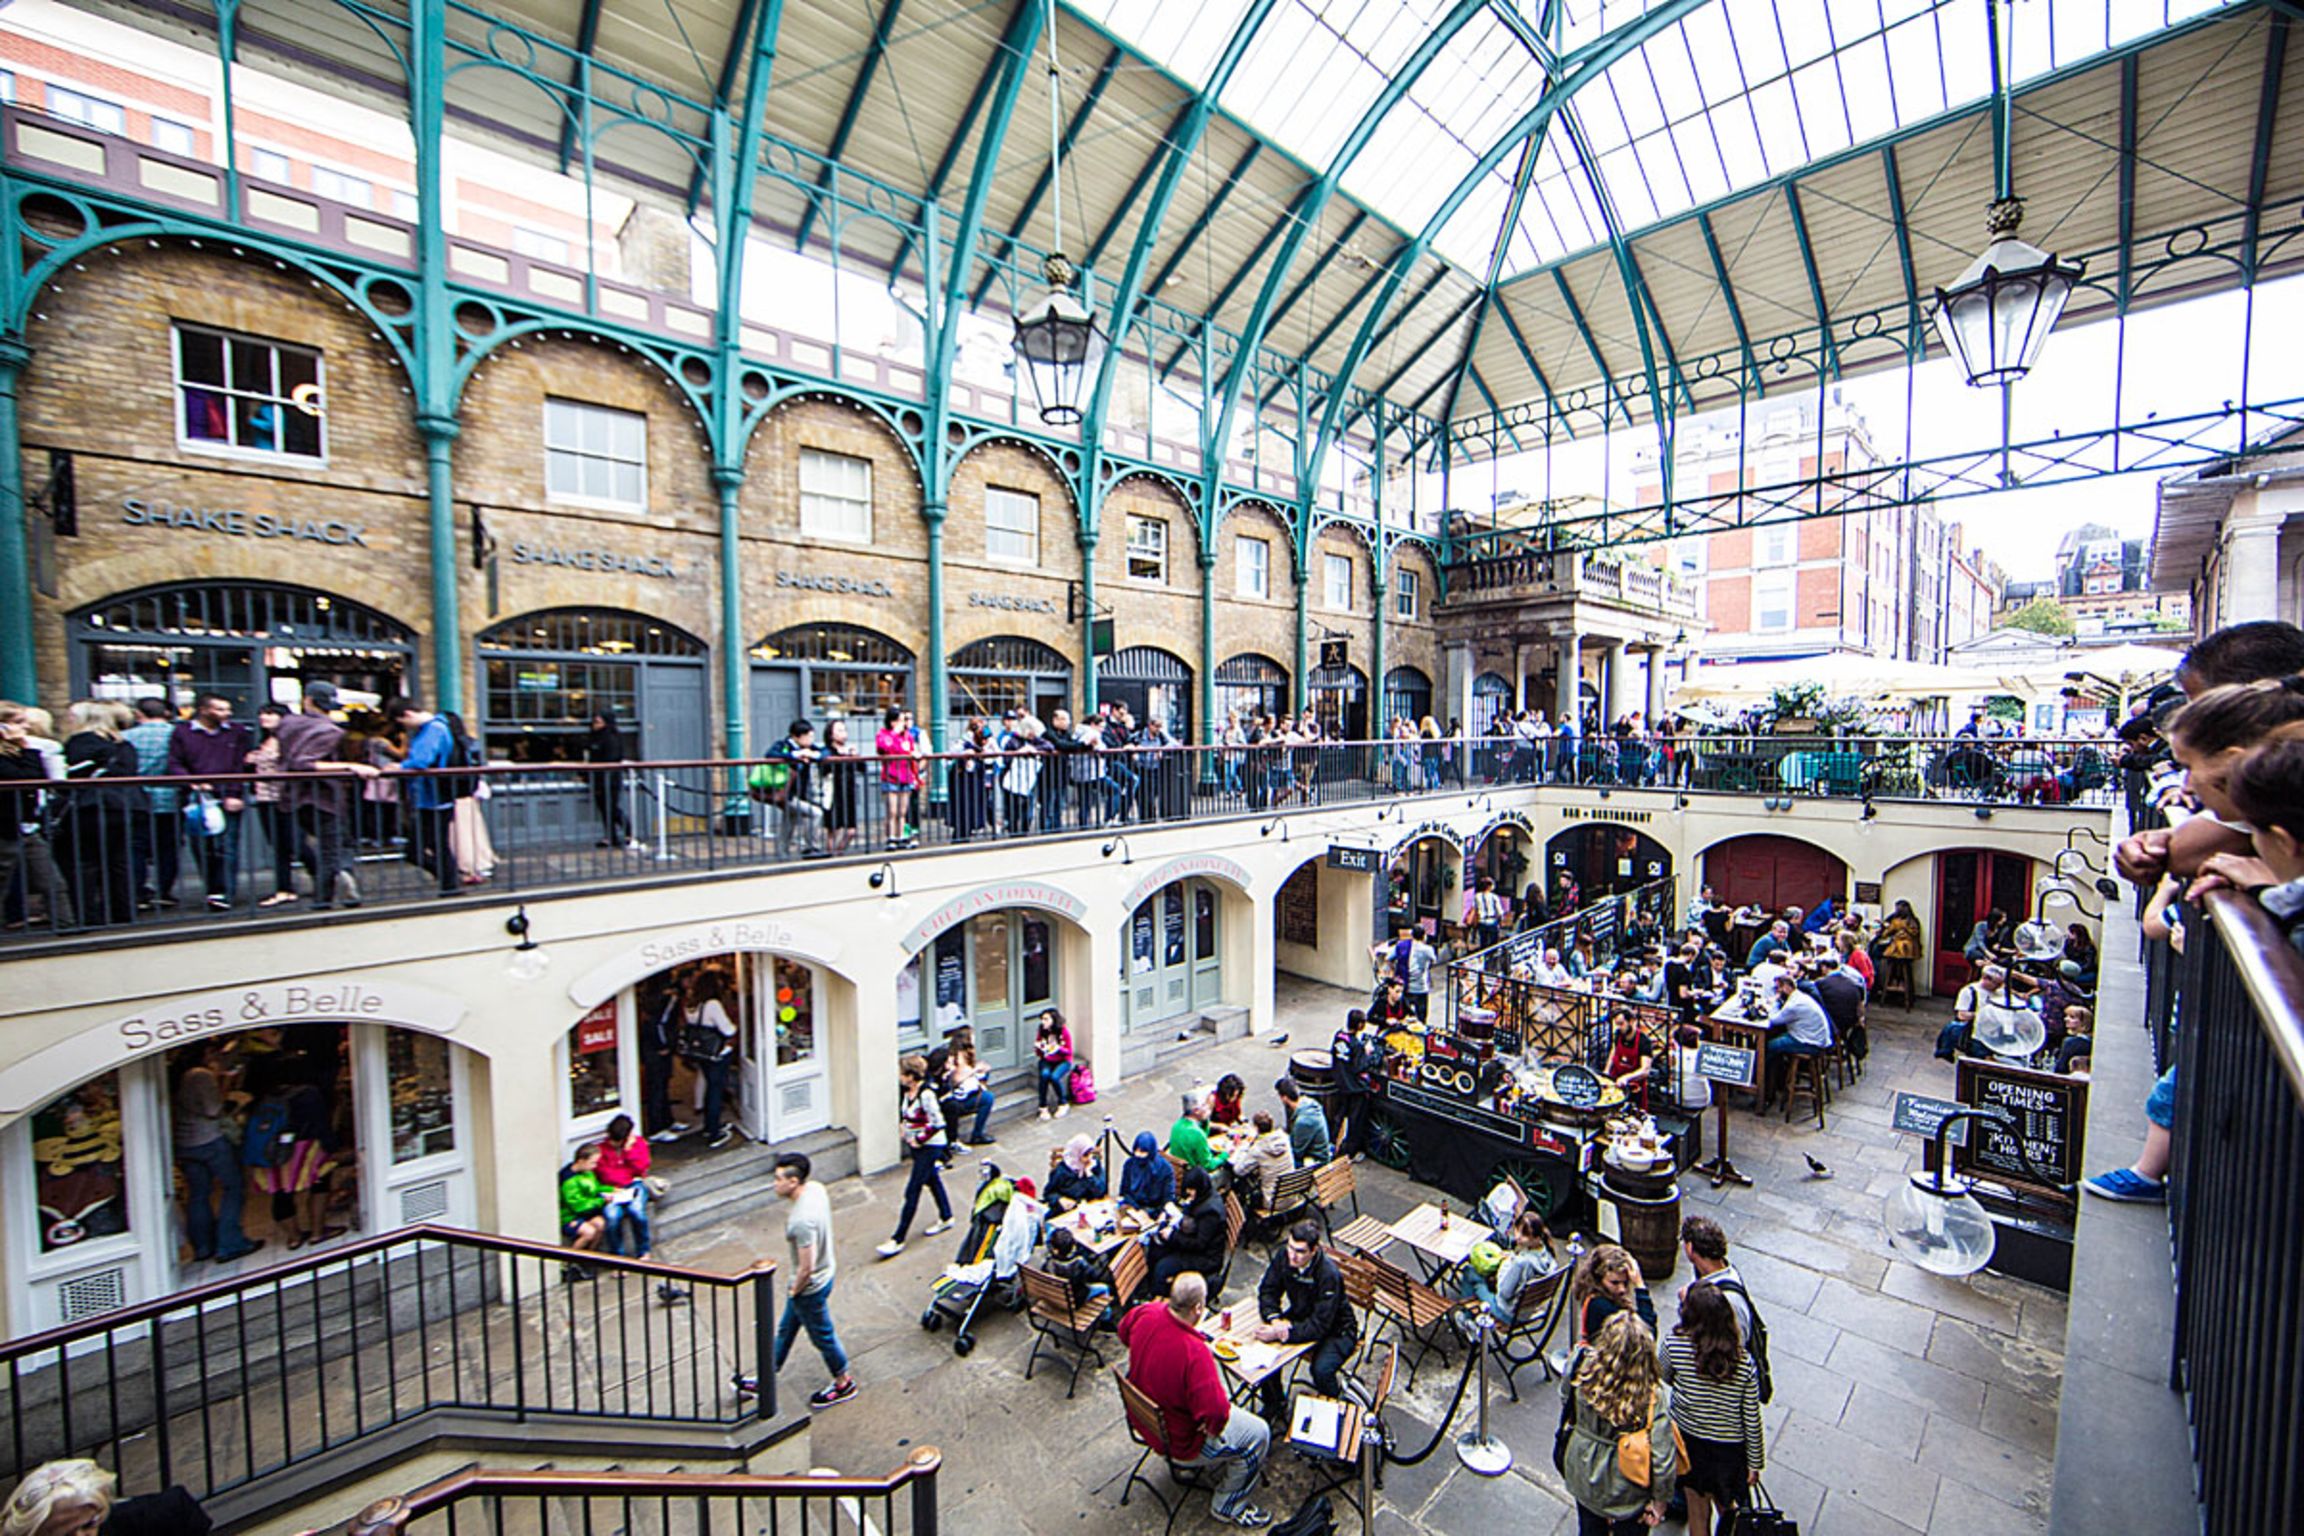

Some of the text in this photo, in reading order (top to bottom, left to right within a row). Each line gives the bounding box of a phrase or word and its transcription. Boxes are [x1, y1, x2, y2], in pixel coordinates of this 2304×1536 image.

[123, 499, 369, 548] SHAKE SHACK
[511, 543, 677, 579] SHAKE SHACK
[775, 571, 835, 594] SHAKE
[1340, 850, 1366, 868] Exit
[641, 922, 794, 969] Sass & Belle
[119, 985, 385, 1050] Sass & Belle
[583, 1028, 614, 1047] SALE
[1988, 1080, 2055, 1104] OPENING
[2000, 1093, 2044, 1112] TIMES
[1999, 1143, 2042, 1162] HORS
